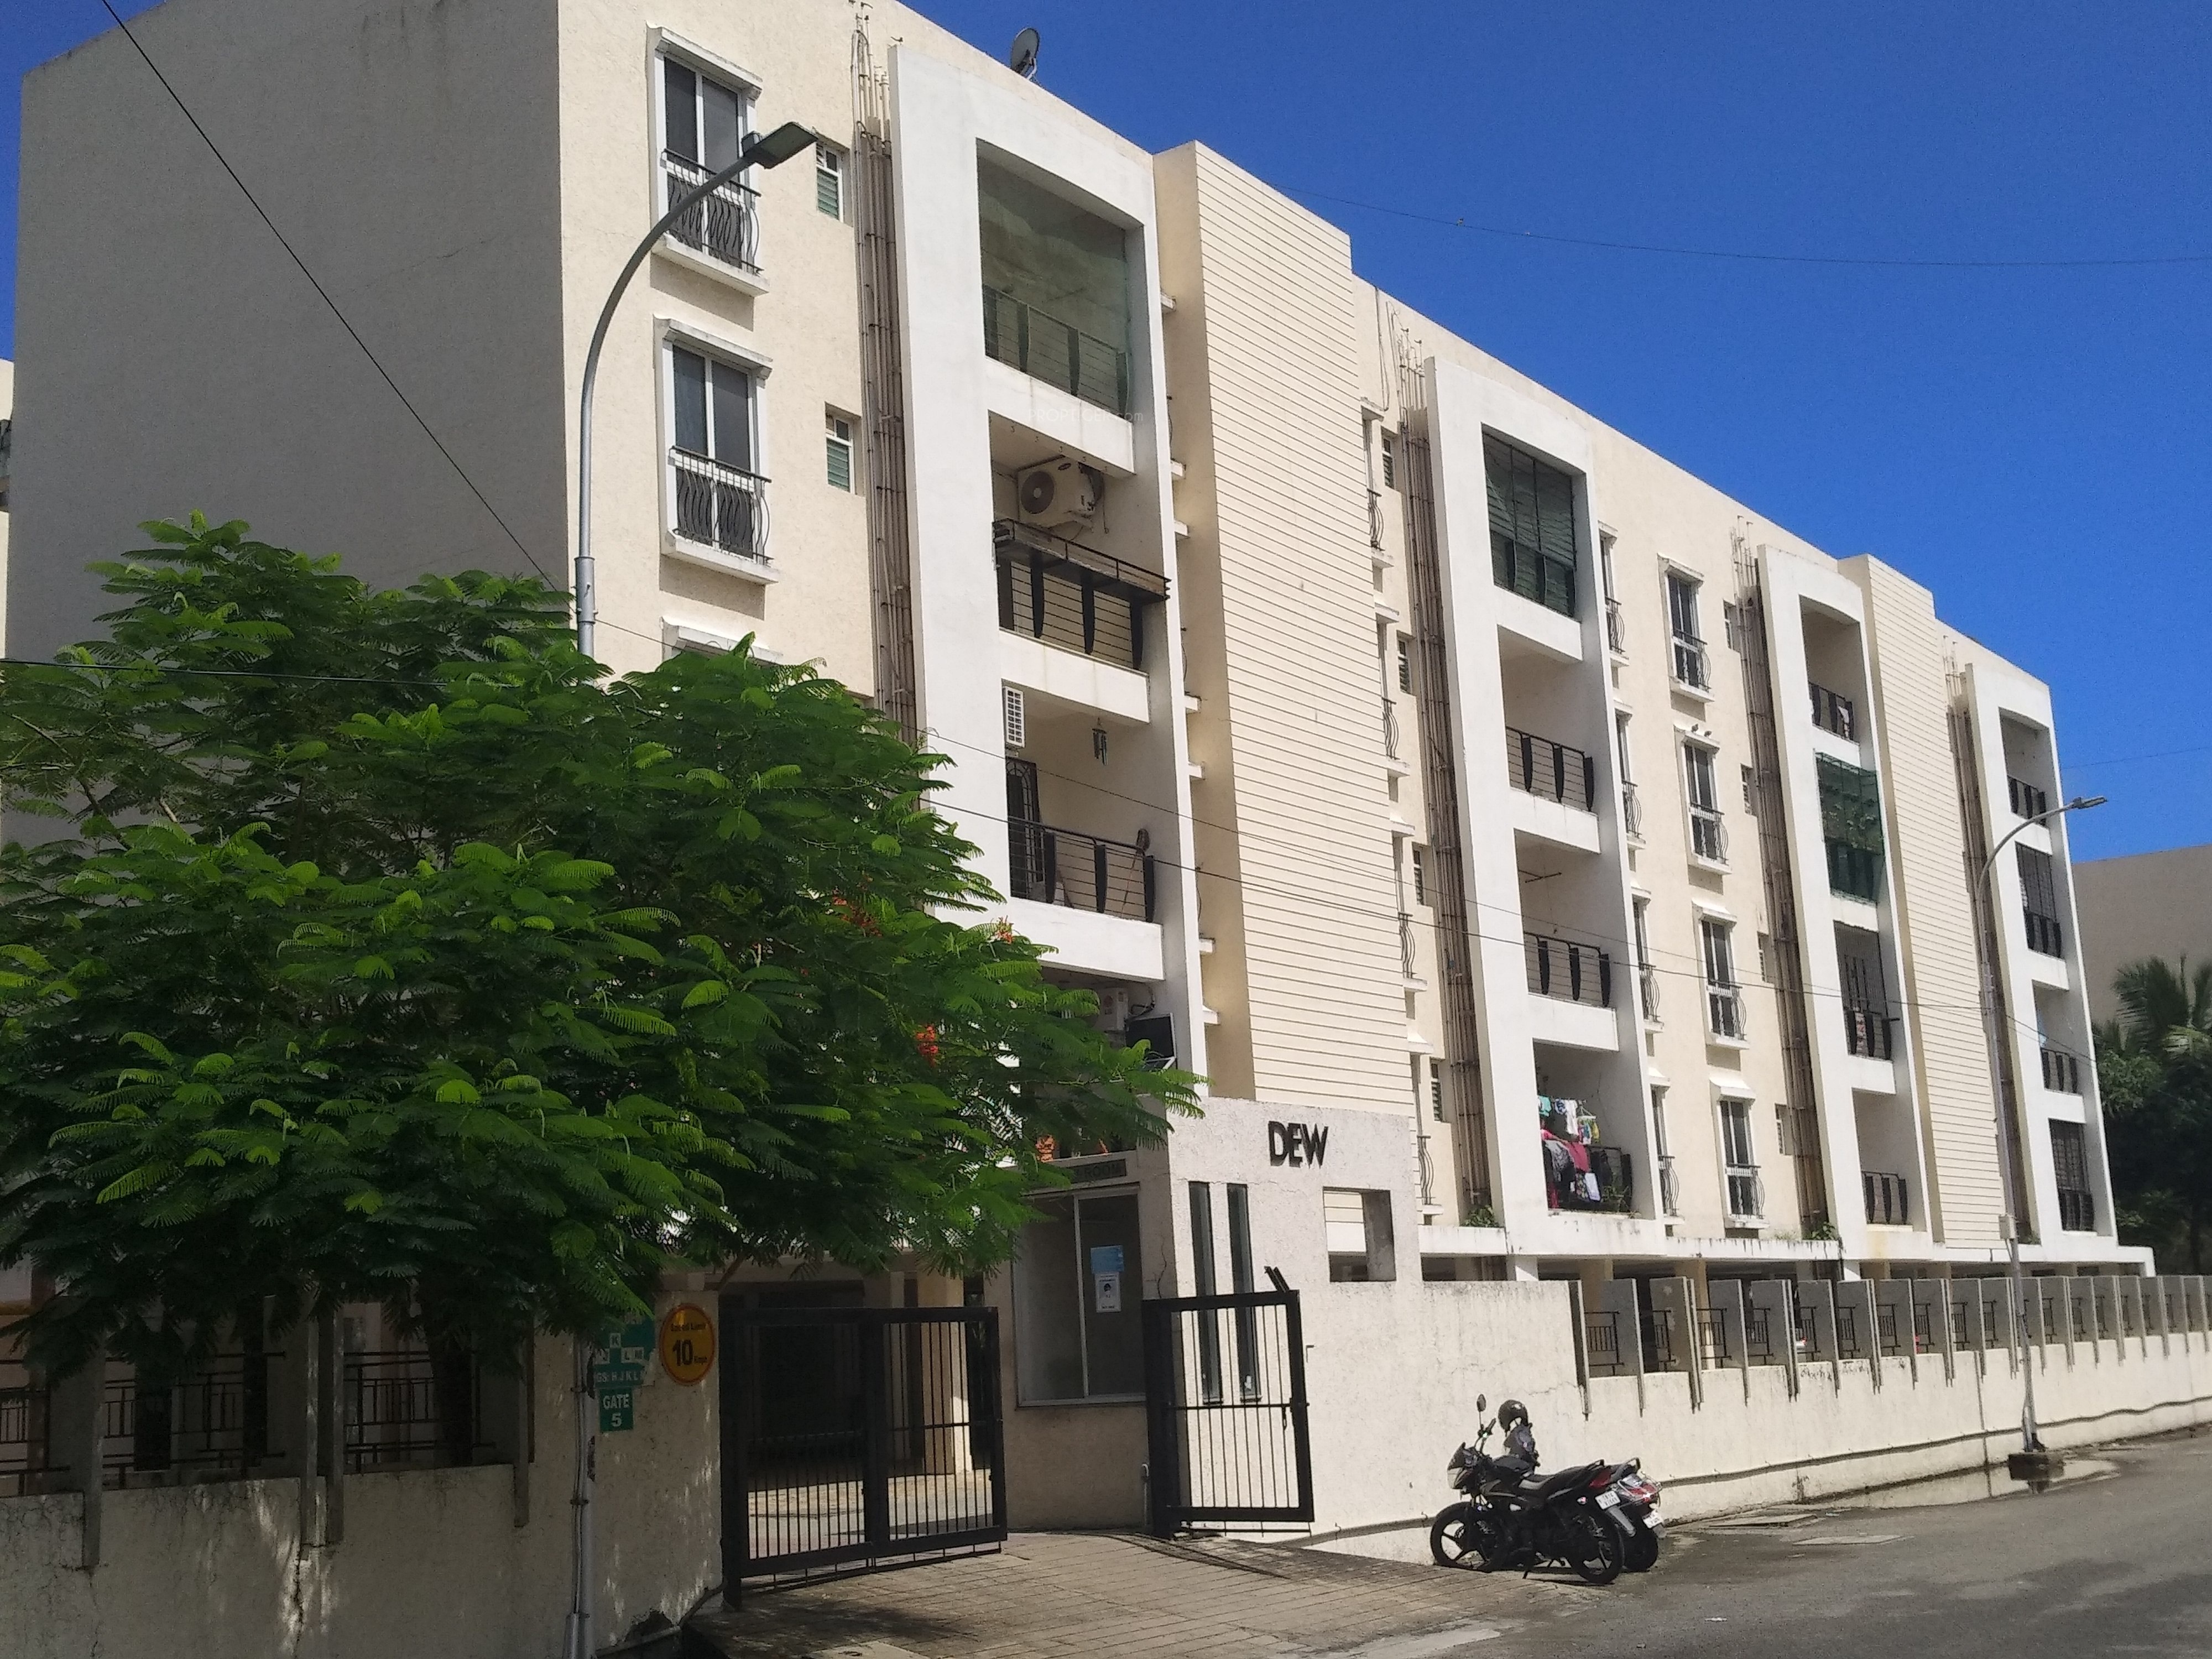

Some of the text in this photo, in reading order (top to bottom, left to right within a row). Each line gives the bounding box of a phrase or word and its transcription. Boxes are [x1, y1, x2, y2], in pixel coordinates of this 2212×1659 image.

[1268, 1121, 1328, 1169] DEW
[1084, 1162, 1121, 1179] ROOM
[672, 1339, 693, 1366] 10
[603, 1394, 629, 1410] GATE
[611, 1412, 622, 1427] 5
